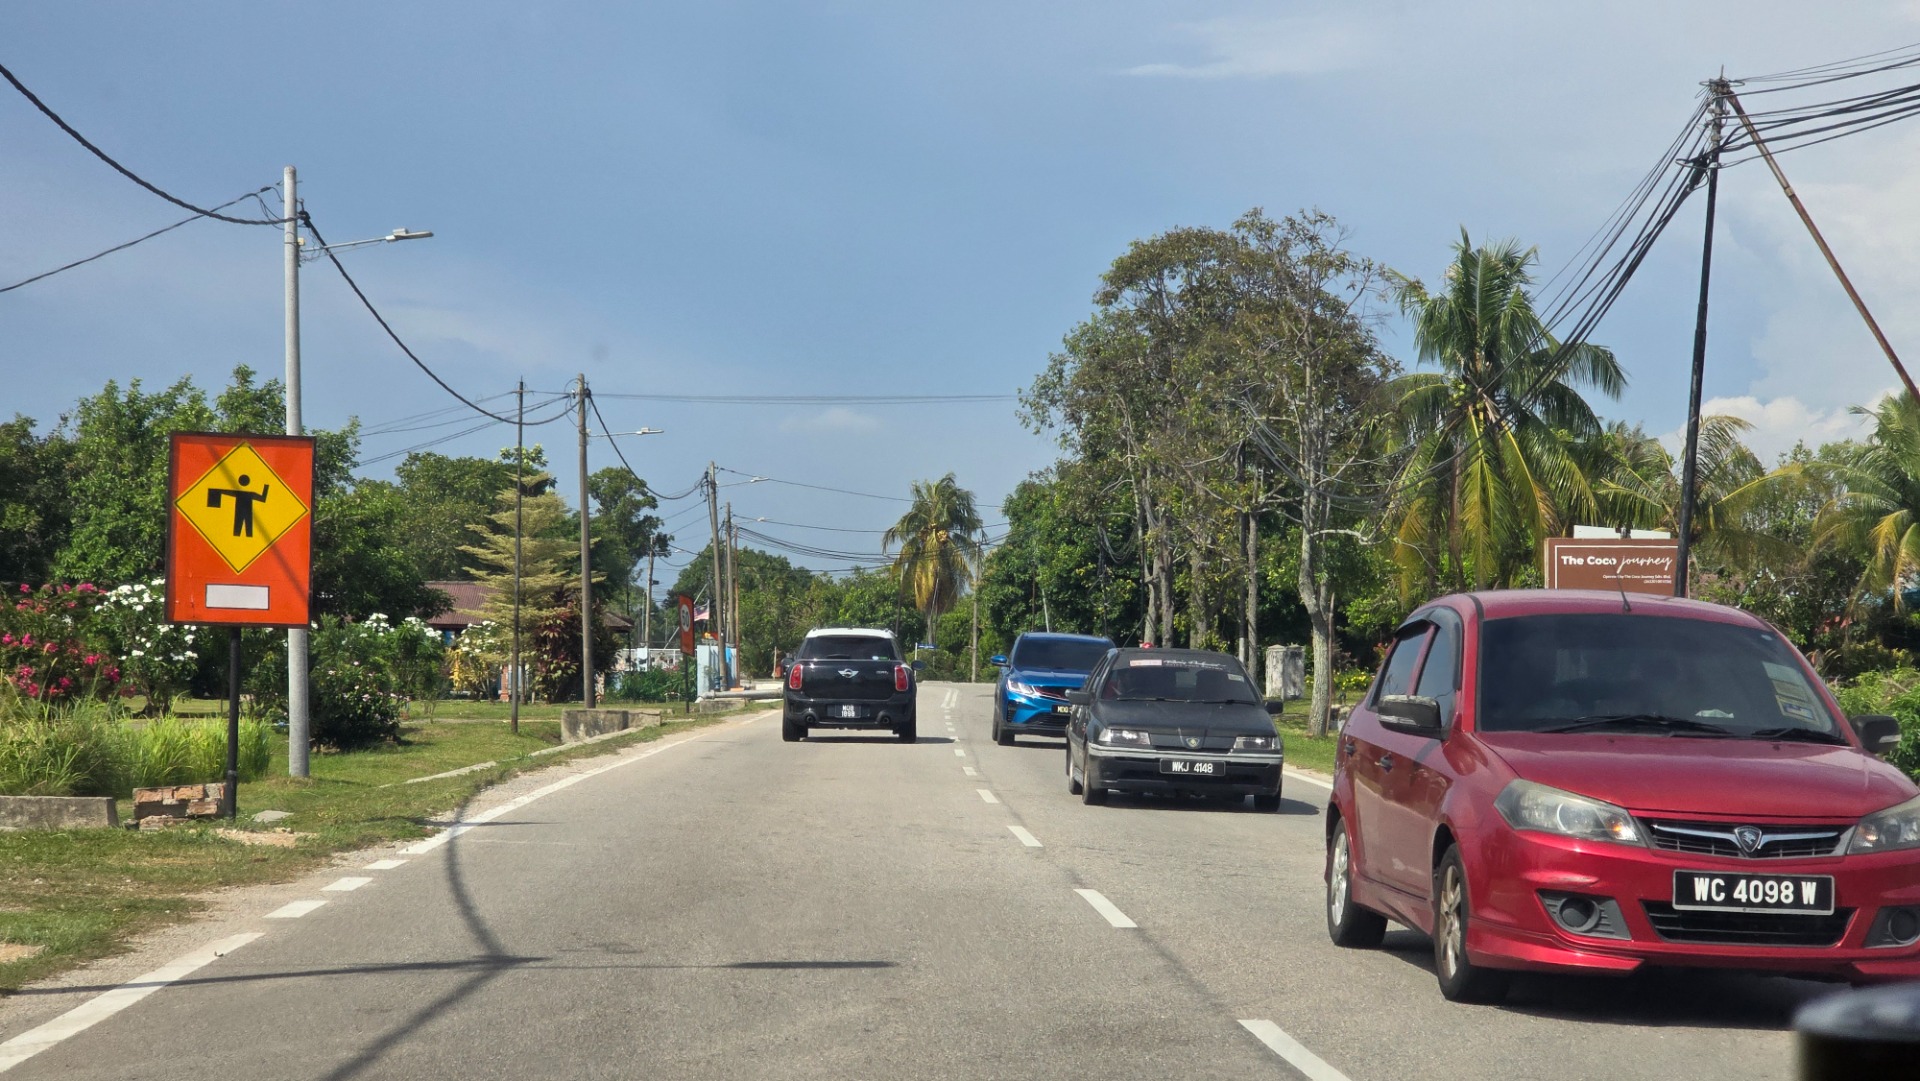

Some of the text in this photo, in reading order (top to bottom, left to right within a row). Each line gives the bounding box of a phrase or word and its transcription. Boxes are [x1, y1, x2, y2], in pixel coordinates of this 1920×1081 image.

[1561, 555, 1673, 574] The Coco journey
[1172, 761, 1214, 773] WKJ 4148
[1694, 877, 1817, 905] WC 4098 W
